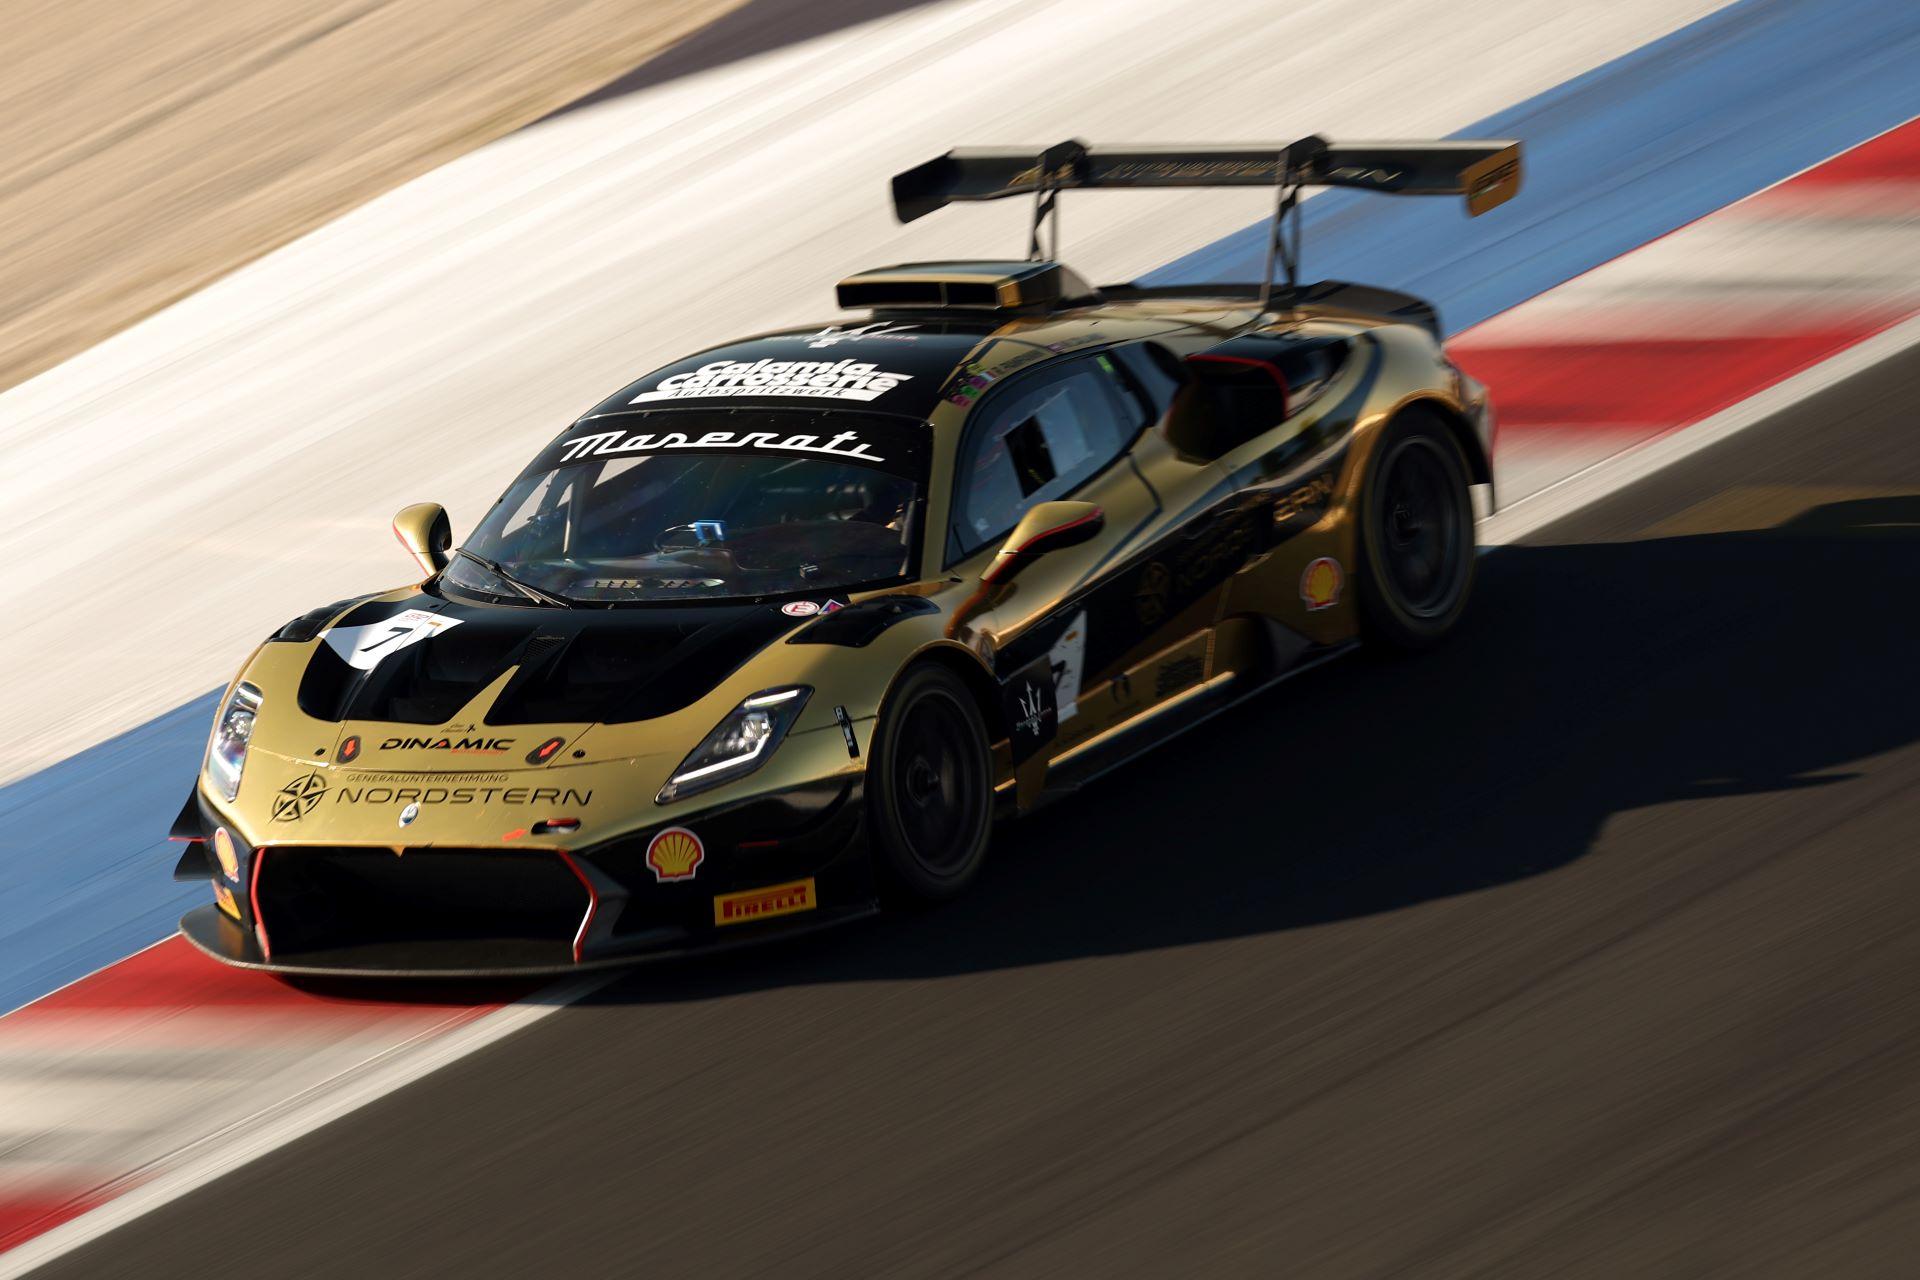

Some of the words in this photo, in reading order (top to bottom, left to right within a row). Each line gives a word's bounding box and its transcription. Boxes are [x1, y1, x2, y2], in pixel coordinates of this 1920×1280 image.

[695, 358, 880, 376] Calamia
[656, 371, 901, 392] Carrosserie
[559, 430, 886, 462] Maserati
[359, 626, 414, 652] 7
[379, 738, 517, 751] DINAMIC
[345, 773, 510, 784] GENERALUNTERNEHMUNG
[334, 787, 594, 807] NORDSTERN
[721, 885, 808, 920] PIRELLI
